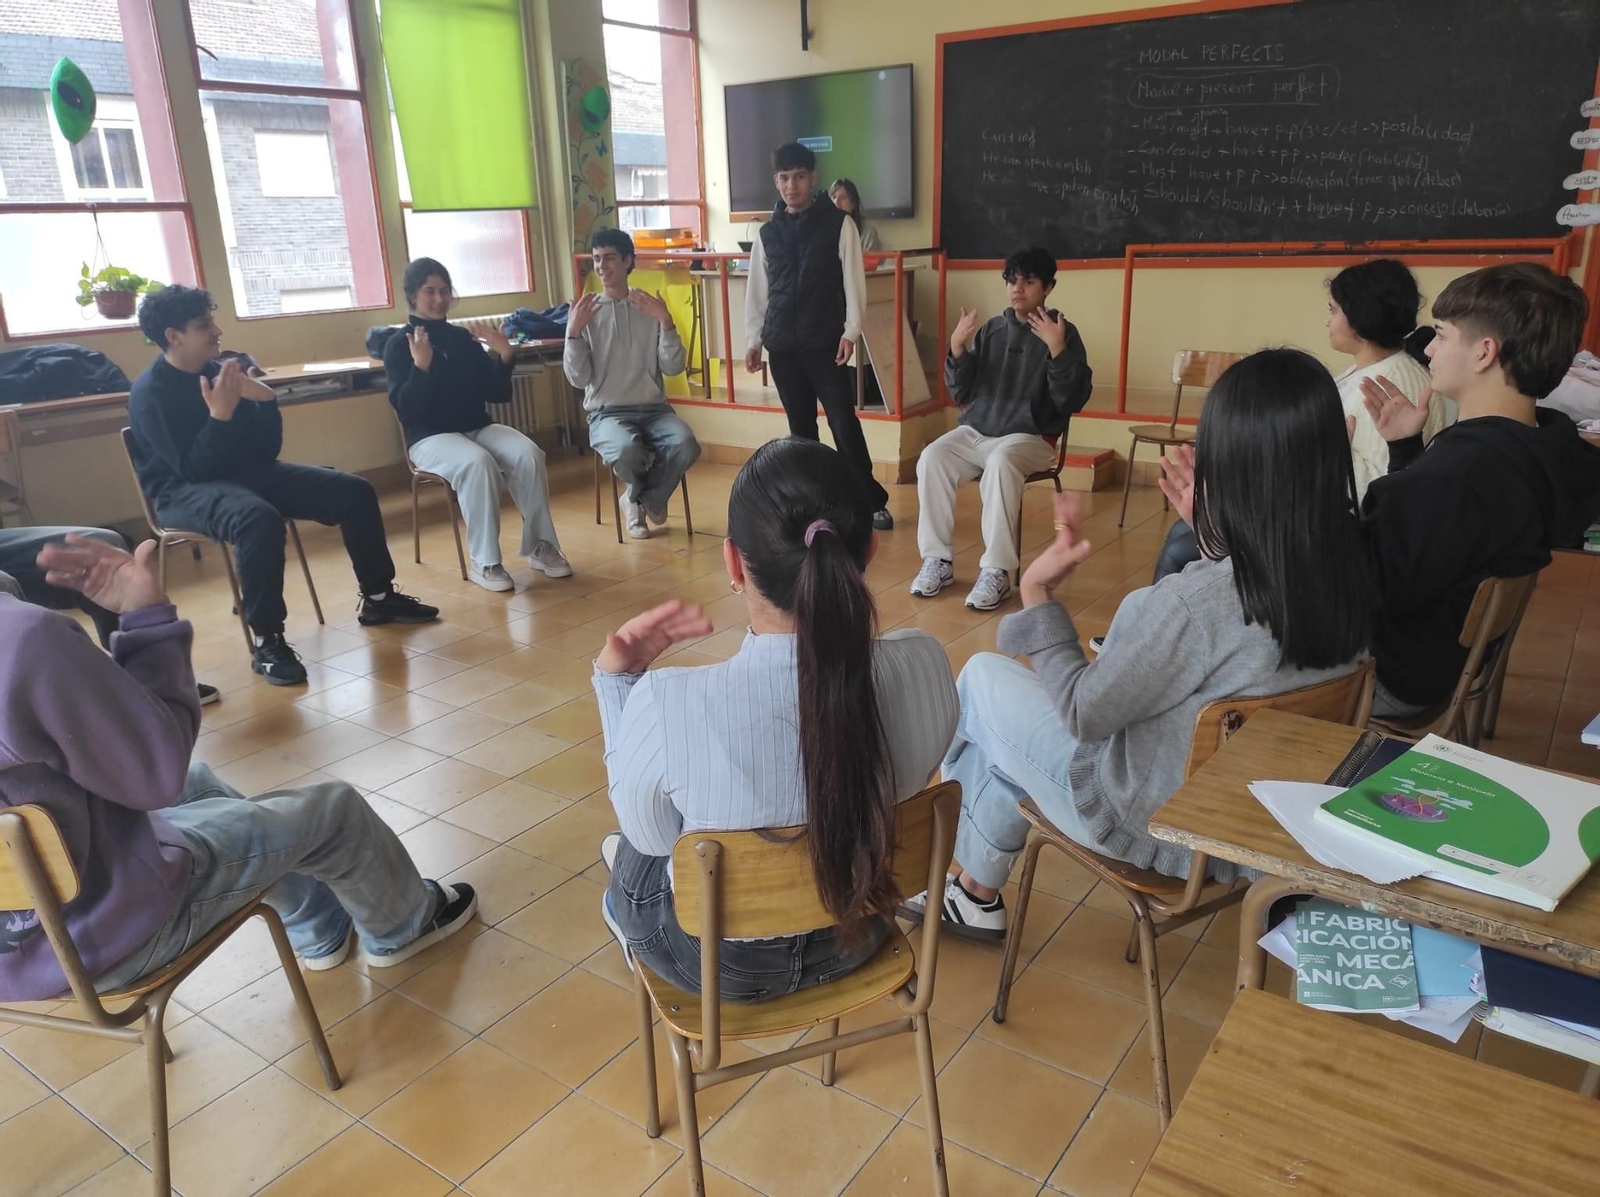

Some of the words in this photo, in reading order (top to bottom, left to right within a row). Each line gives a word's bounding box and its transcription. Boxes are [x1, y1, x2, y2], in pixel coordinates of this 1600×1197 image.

[1139, 49, 1188, 65] MODAL
[1201, 43, 1286, 63] PERFECTS
[1199, 76, 1256, 102] present
[1273, 71, 1328, 102] perfect
